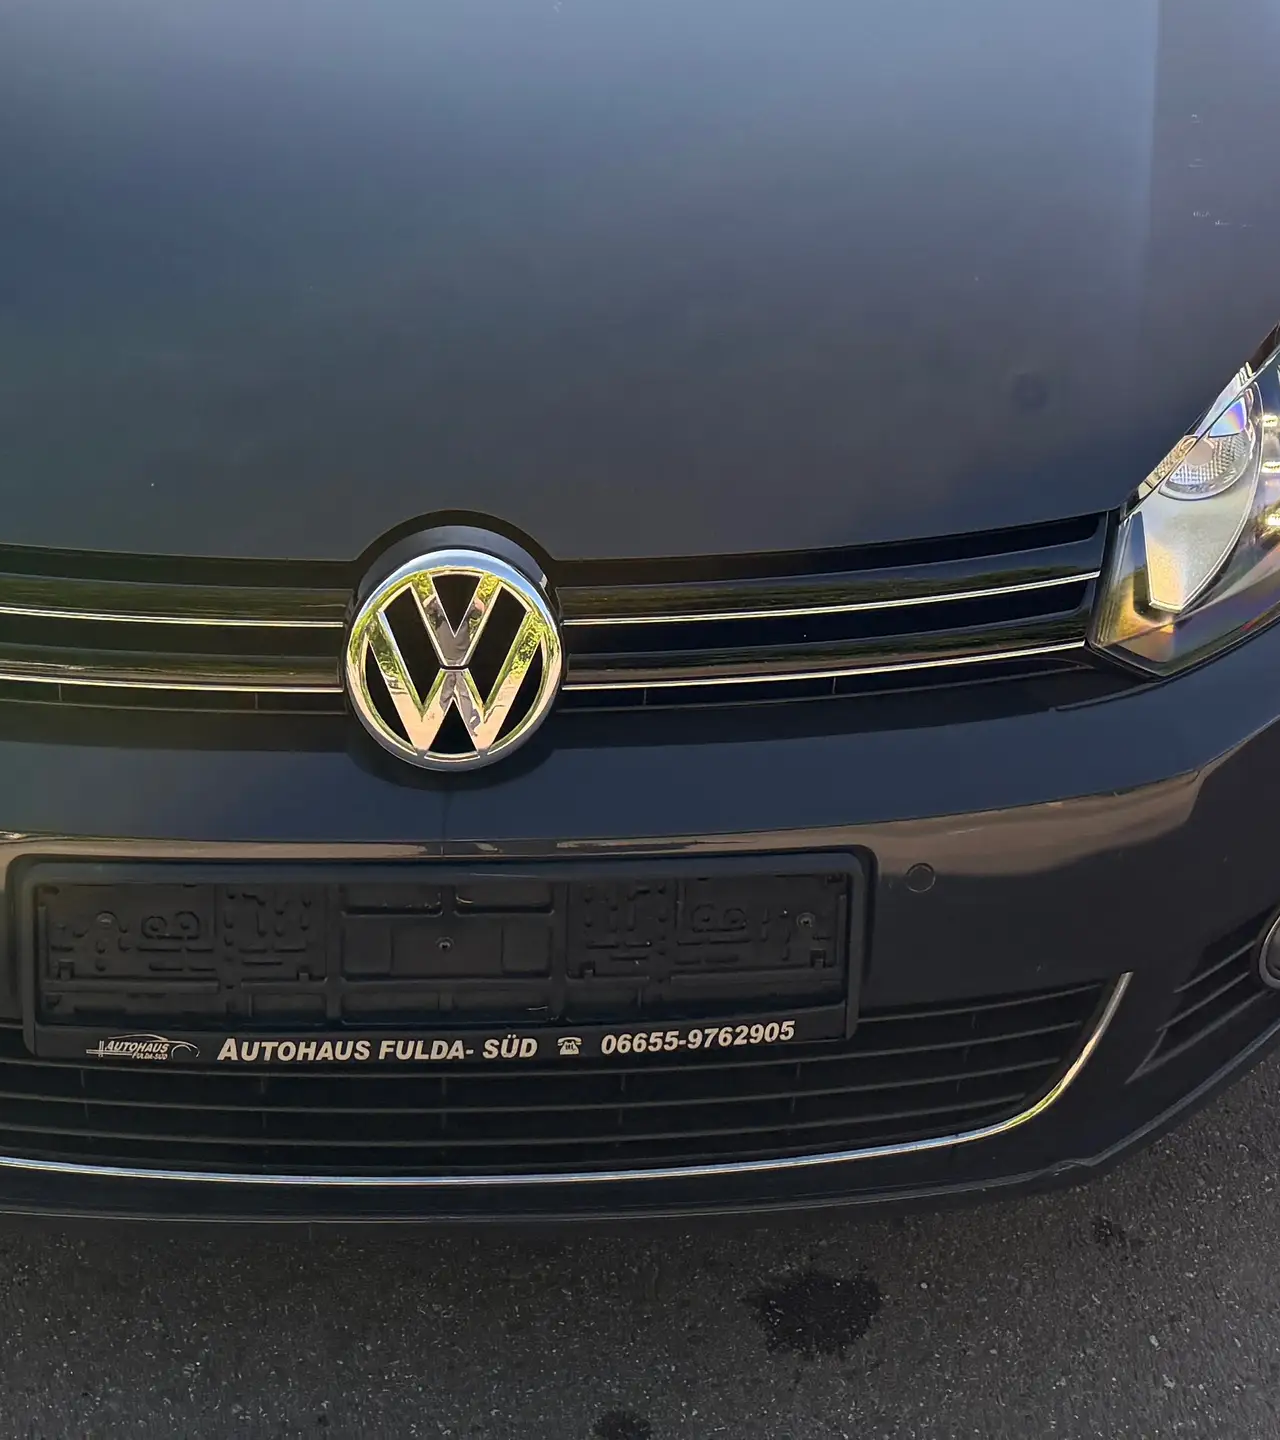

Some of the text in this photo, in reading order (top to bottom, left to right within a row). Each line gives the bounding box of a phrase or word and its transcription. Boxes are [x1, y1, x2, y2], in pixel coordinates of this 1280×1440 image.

[105, 1040, 170, 1053] AUTOHAUS
[378, 1039, 474, 1061] FULDA-
[482, 1033, 538, 1059] SÜD
[601, 1020, 796, 1055] 06655-9762905
